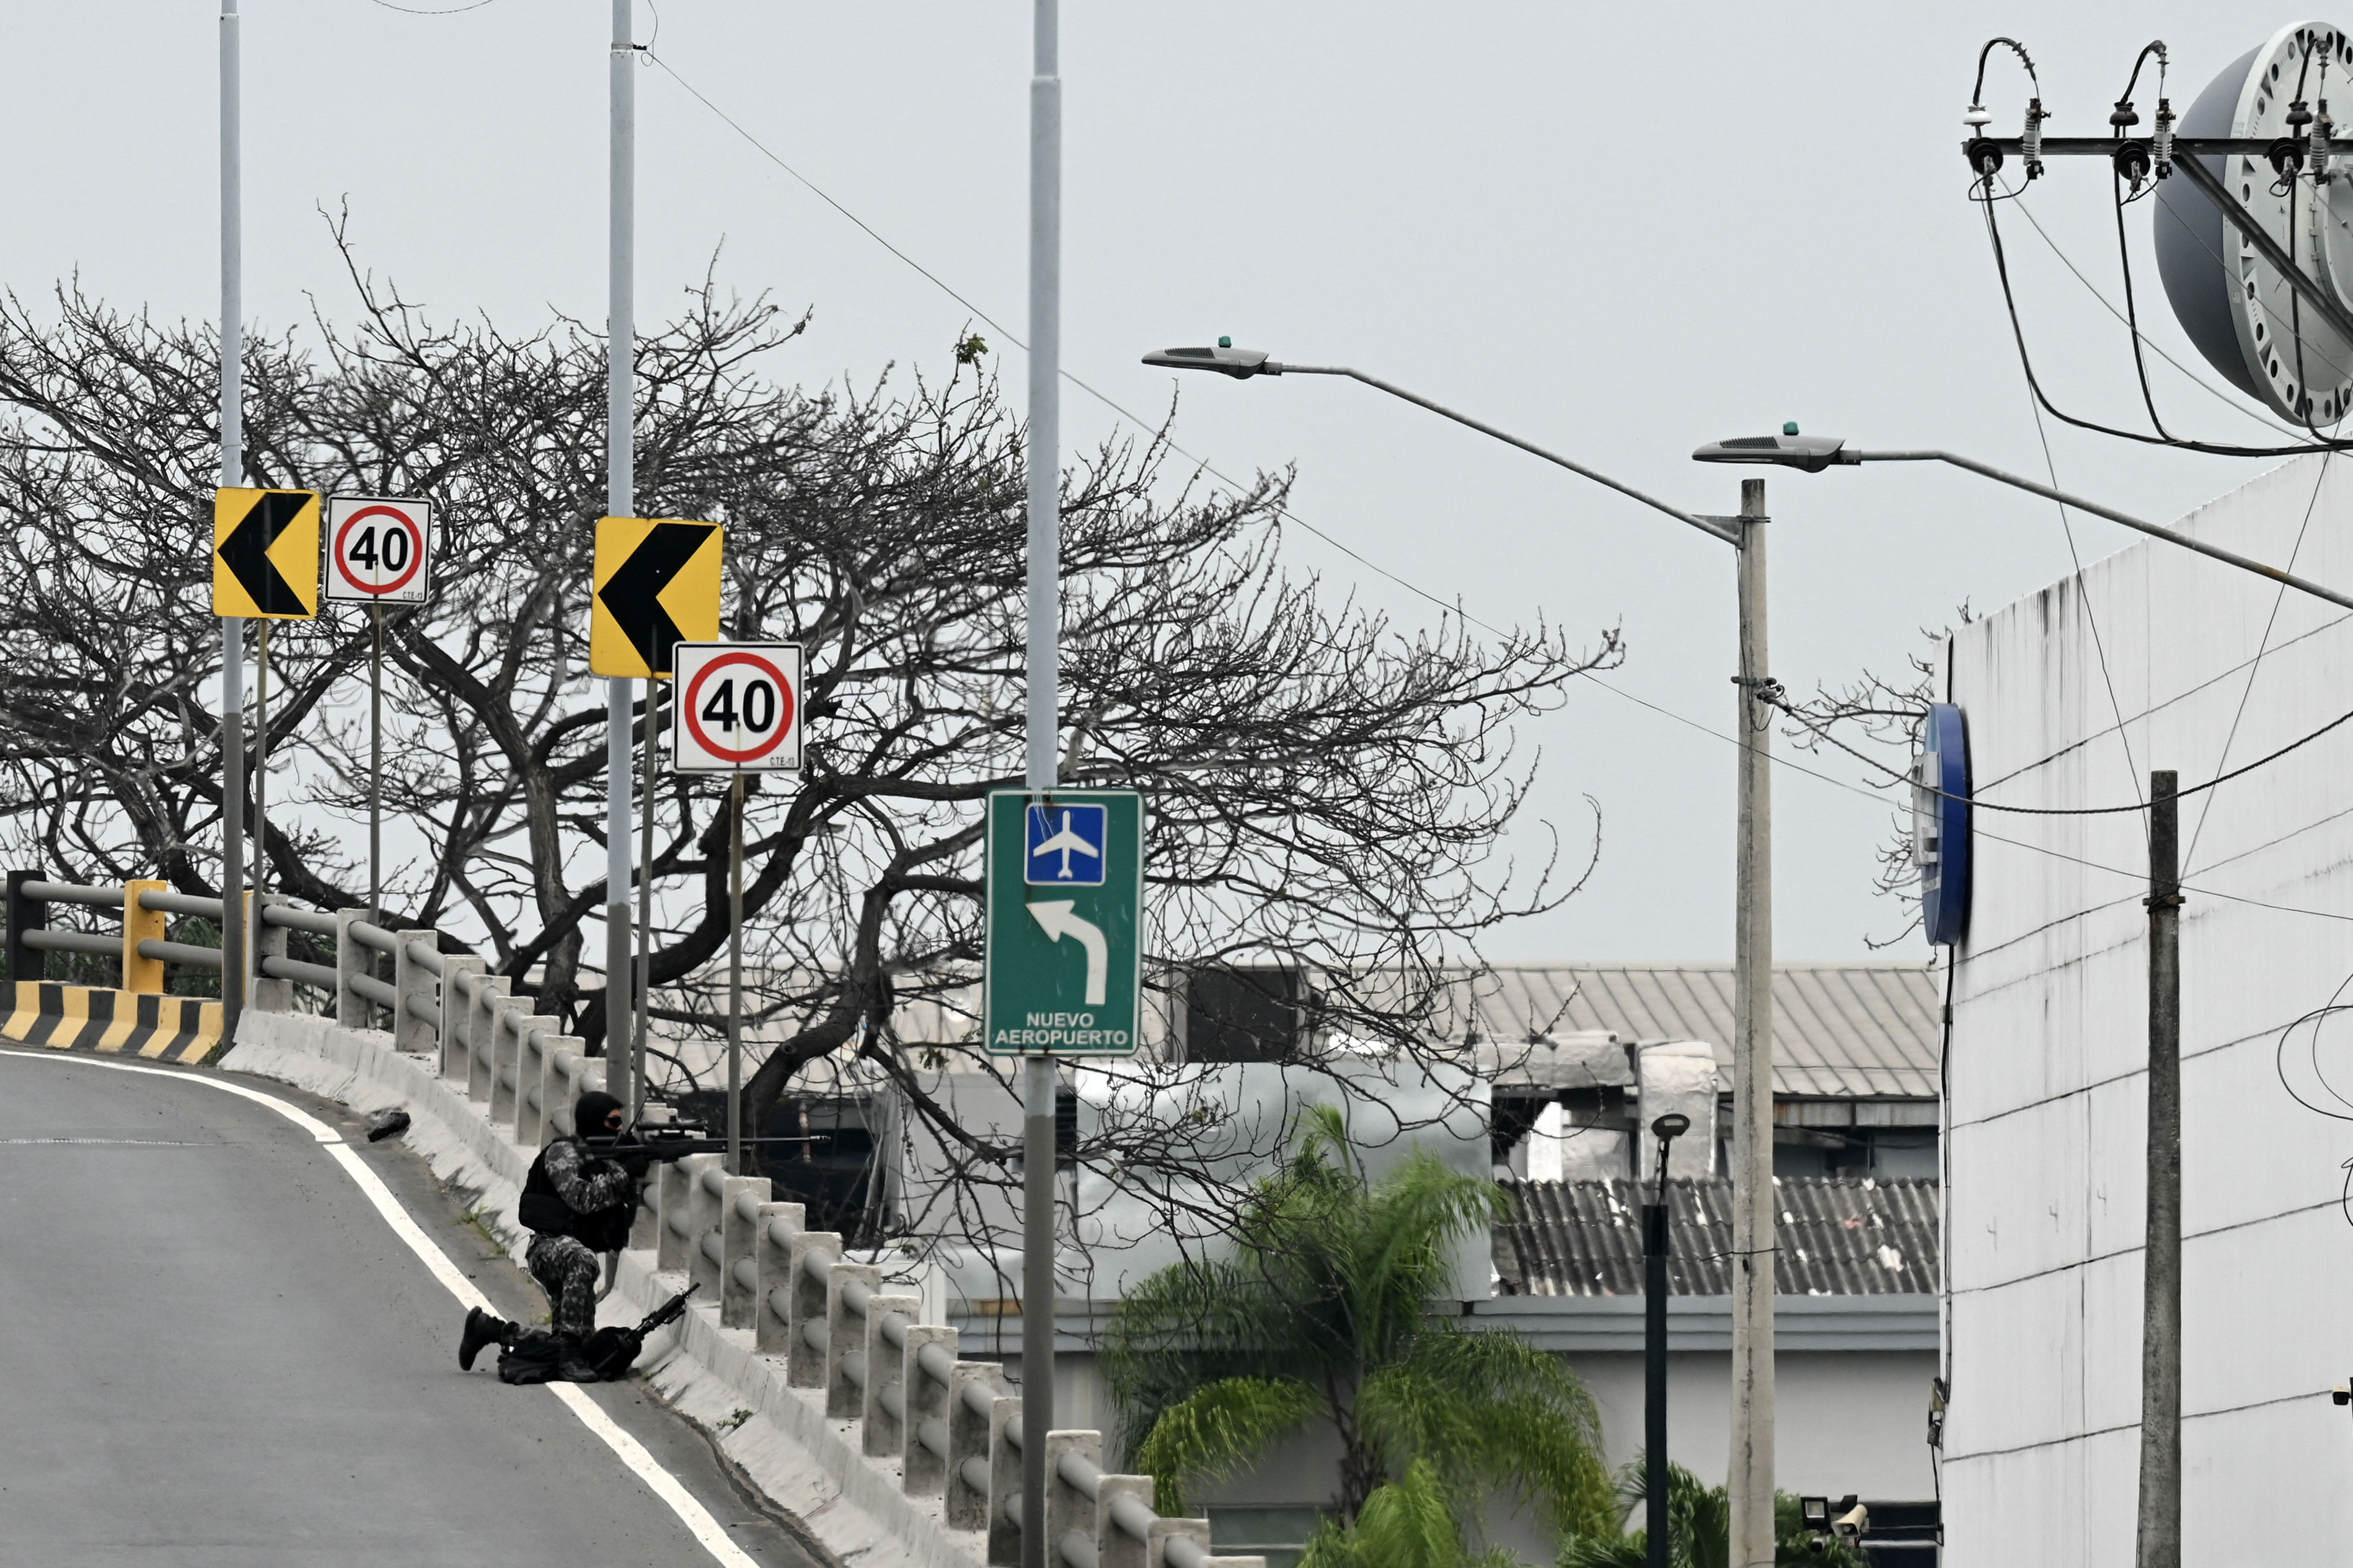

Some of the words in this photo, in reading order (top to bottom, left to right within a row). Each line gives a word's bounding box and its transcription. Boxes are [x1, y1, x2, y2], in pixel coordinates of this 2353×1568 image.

[349, 526, 408, 571] 40
[702, 679, 775, 733] 40
[1026, 1011, 1094, 1028] NUEVO
[995, 1029, 1129, 1045] AEROPUERTO
